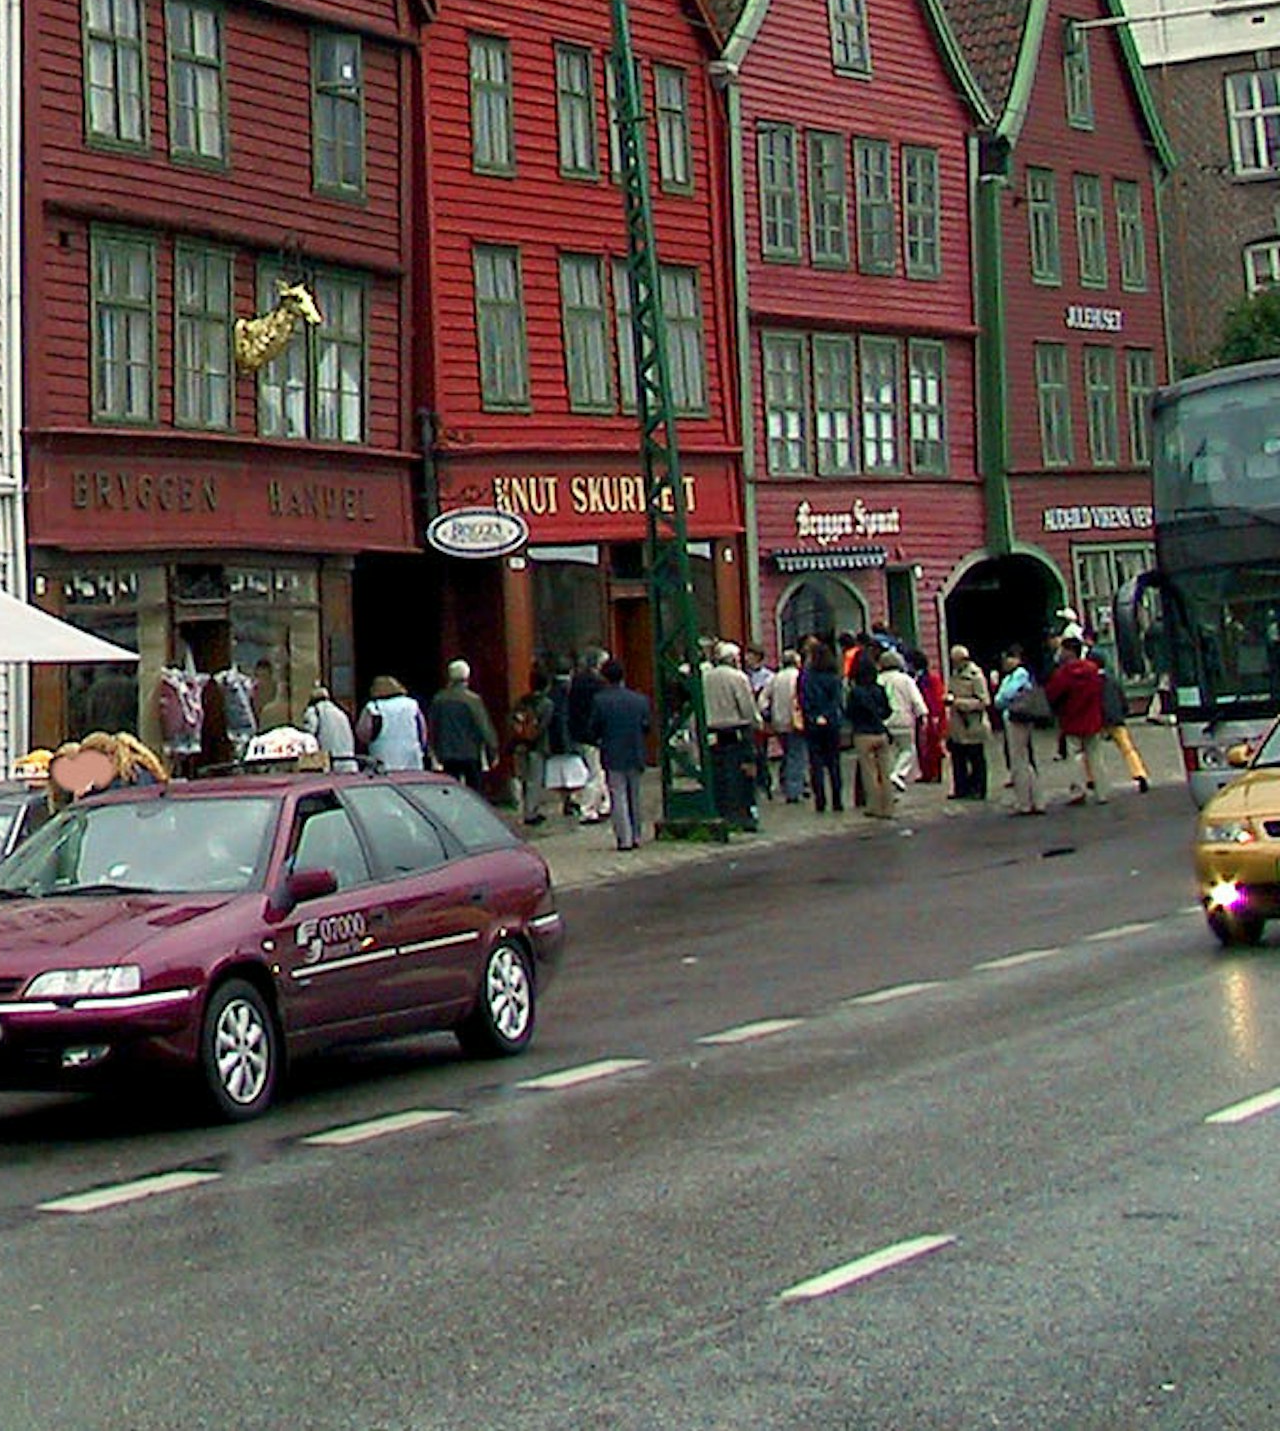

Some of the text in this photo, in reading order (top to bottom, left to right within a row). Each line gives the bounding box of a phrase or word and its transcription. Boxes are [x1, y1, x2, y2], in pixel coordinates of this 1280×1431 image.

[71, 469, 376, 523] BRYGGEN HANDEL
[494, 476, 558, 514] KNUT
